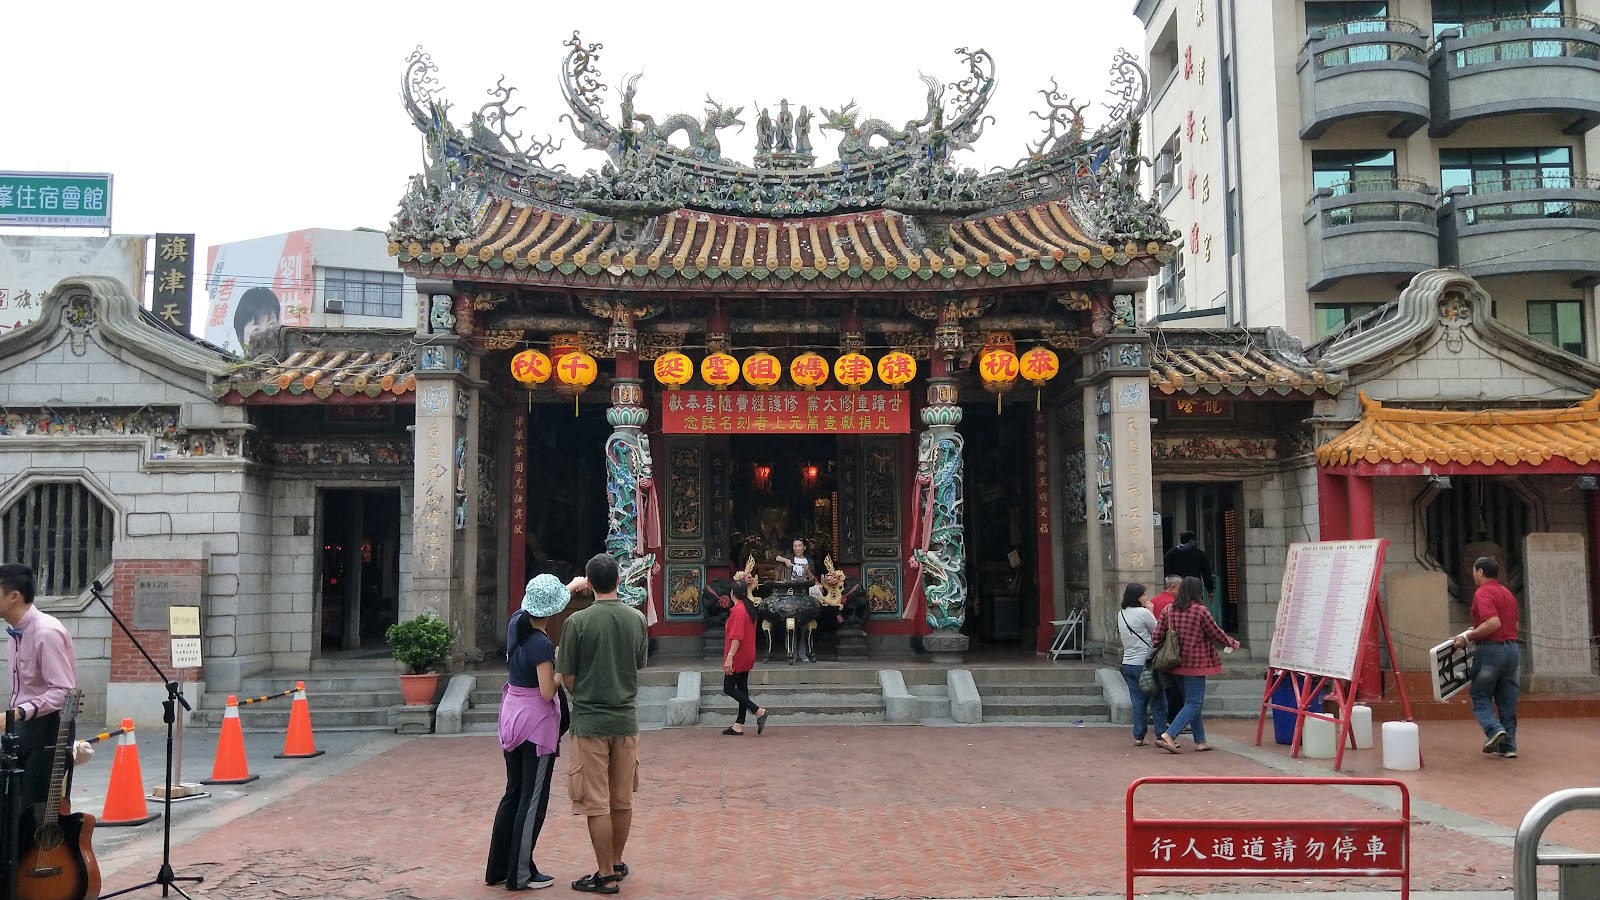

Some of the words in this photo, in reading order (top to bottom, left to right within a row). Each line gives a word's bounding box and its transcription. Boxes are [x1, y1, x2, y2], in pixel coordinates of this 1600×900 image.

[513, 353, 546, 378] 秋
[561, 355, 590, 380] 千
[656, 356, 684, 379] 誕
[705, 357, 731, 380] 聖
[746, 357, 777, 380] 祖
[792, 357, 827, 381] 媽
[839, 356, 869, 381] 津
[881, 355, 913, 379] 旗
[984, 352, 1016, 377] 祝
[1025, 350, 1056, 375] 恭
[1150, 835, 1388, 863] 行人通道請勿停車
